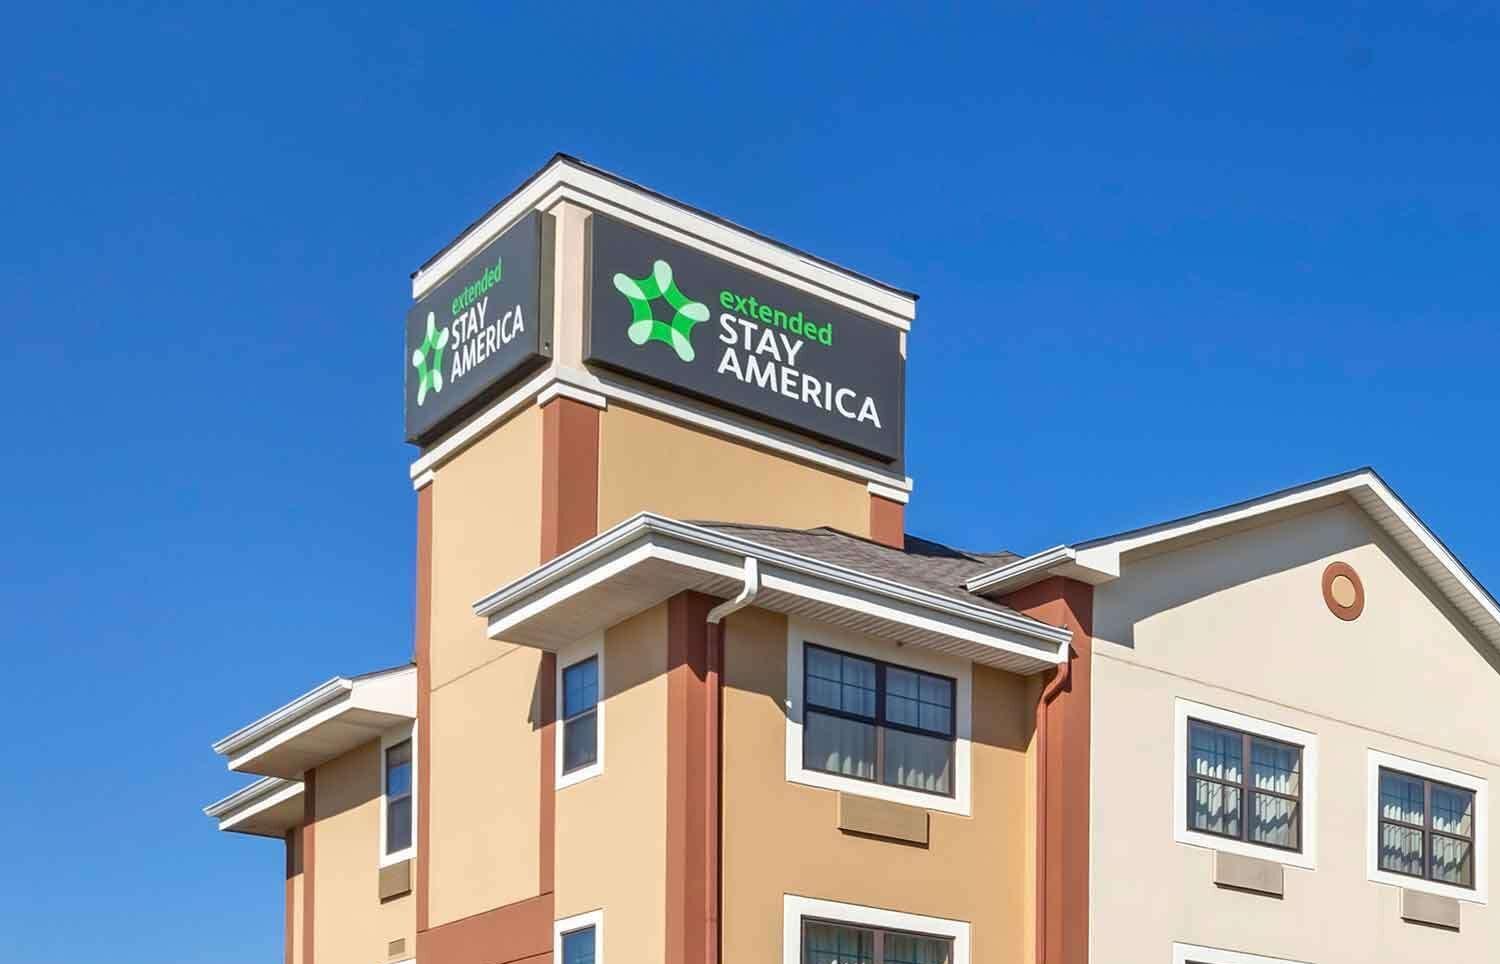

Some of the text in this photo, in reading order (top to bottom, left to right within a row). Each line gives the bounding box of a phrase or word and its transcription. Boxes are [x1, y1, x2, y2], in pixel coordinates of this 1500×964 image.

[452, 256, 502, 315] extended
[450, 304, 524, 383] AMERICA
[451, 296, 488, 350] STAY
[719, 313, 803, 367] STAY
[720, 289, 833, 346] extended
[717, 347, 882, 429] AMERICA
